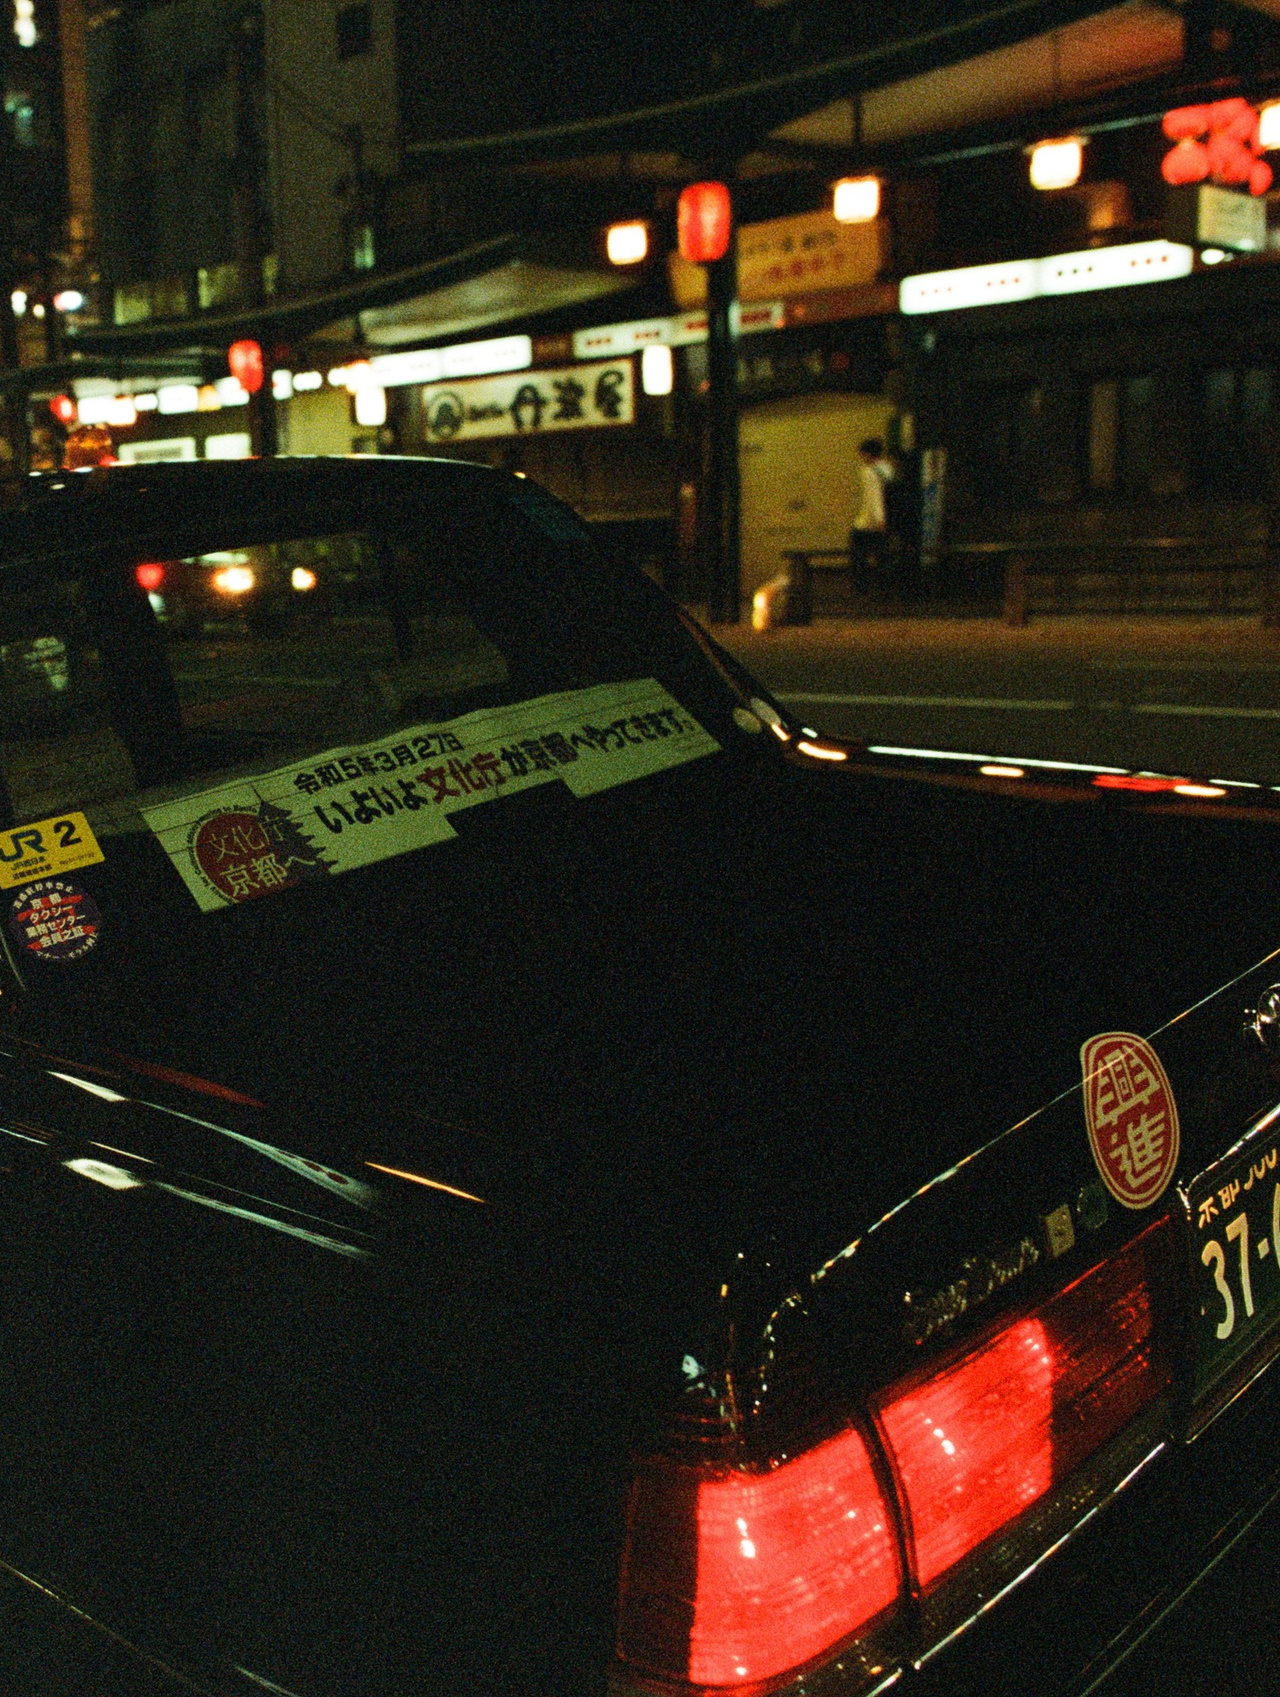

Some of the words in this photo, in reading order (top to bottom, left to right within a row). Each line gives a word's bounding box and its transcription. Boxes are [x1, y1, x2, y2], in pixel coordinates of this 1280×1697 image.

[294, 732, 464, 795] 令和5年3月27日
[53, 820, 83, 848] 2
[206, 815, 285, 860] 文化庁
[220, 852, 317, 898] 京都へ
[26, 915, 86, 938] 業務センター
[30, 905, 73, 923] タクシー
